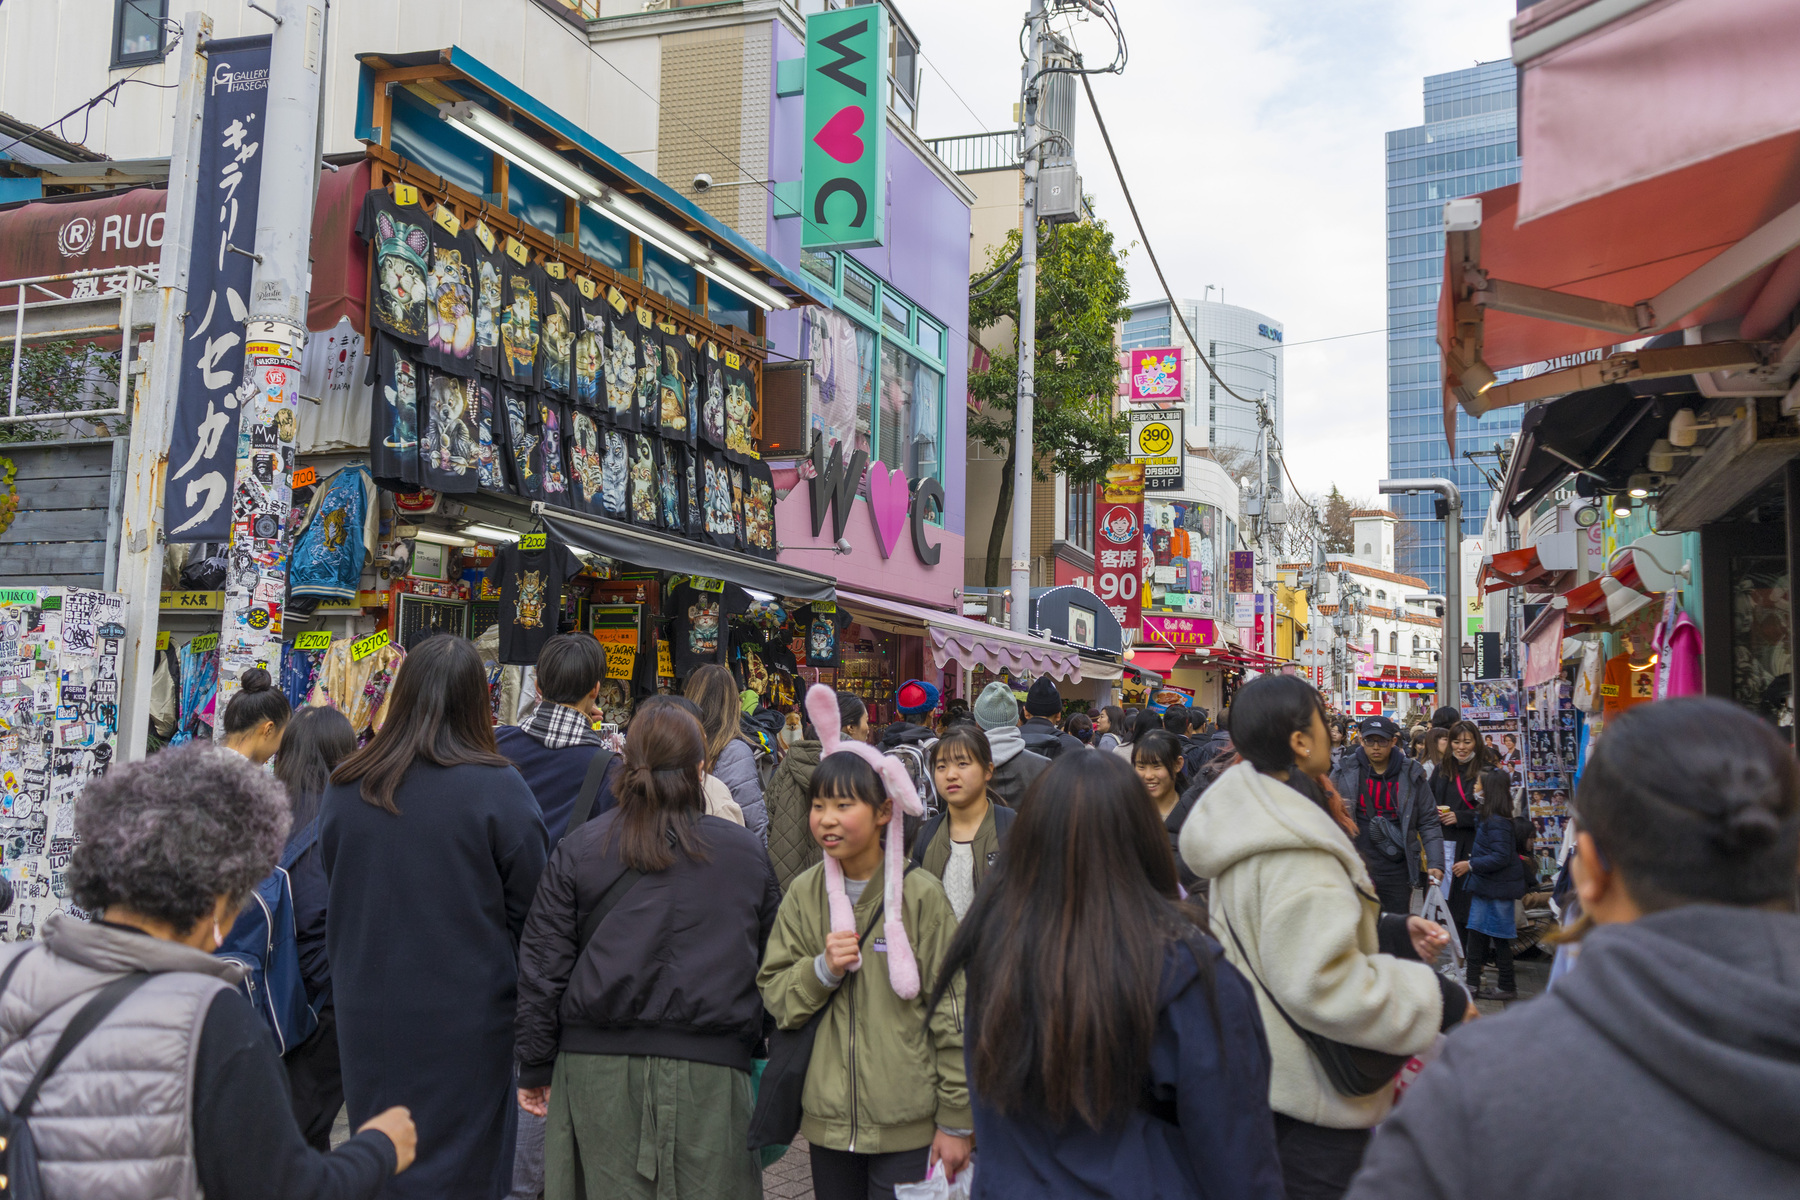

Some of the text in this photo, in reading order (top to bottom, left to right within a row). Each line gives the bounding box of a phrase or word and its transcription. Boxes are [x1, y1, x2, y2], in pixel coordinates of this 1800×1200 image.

[233, 69, 268, 80] GALLERY
[232, 80, 270, 92] HASEGA
[403, 188, 410, 203] 1
[443, 213, 452, 228] 2
[482, 227, 489, 242] 3
[514, 245, 521, 257] 4
[552, 265, 559, 279] 5
[583, 281, 590, 293] 6
[613, 295, 622, 305] 7
[641, 311, 647, 323] 8
[263, 320, 275, 333] 2
[728, 355, 738, 366] 12
[1143, 428, 1170, 441] 390
[519, 534, 546, 549] ¥2000
[1101, 549, 1138, 568] 客席
[1100, 572, 1137, 600] 90
[181, 594, 208, 607] 大人気
[298, 633, 329, 648] ¥2700
[1151, 631, 1206, 643] OUTLET
[354, 632, 388, 659] ¥2700
